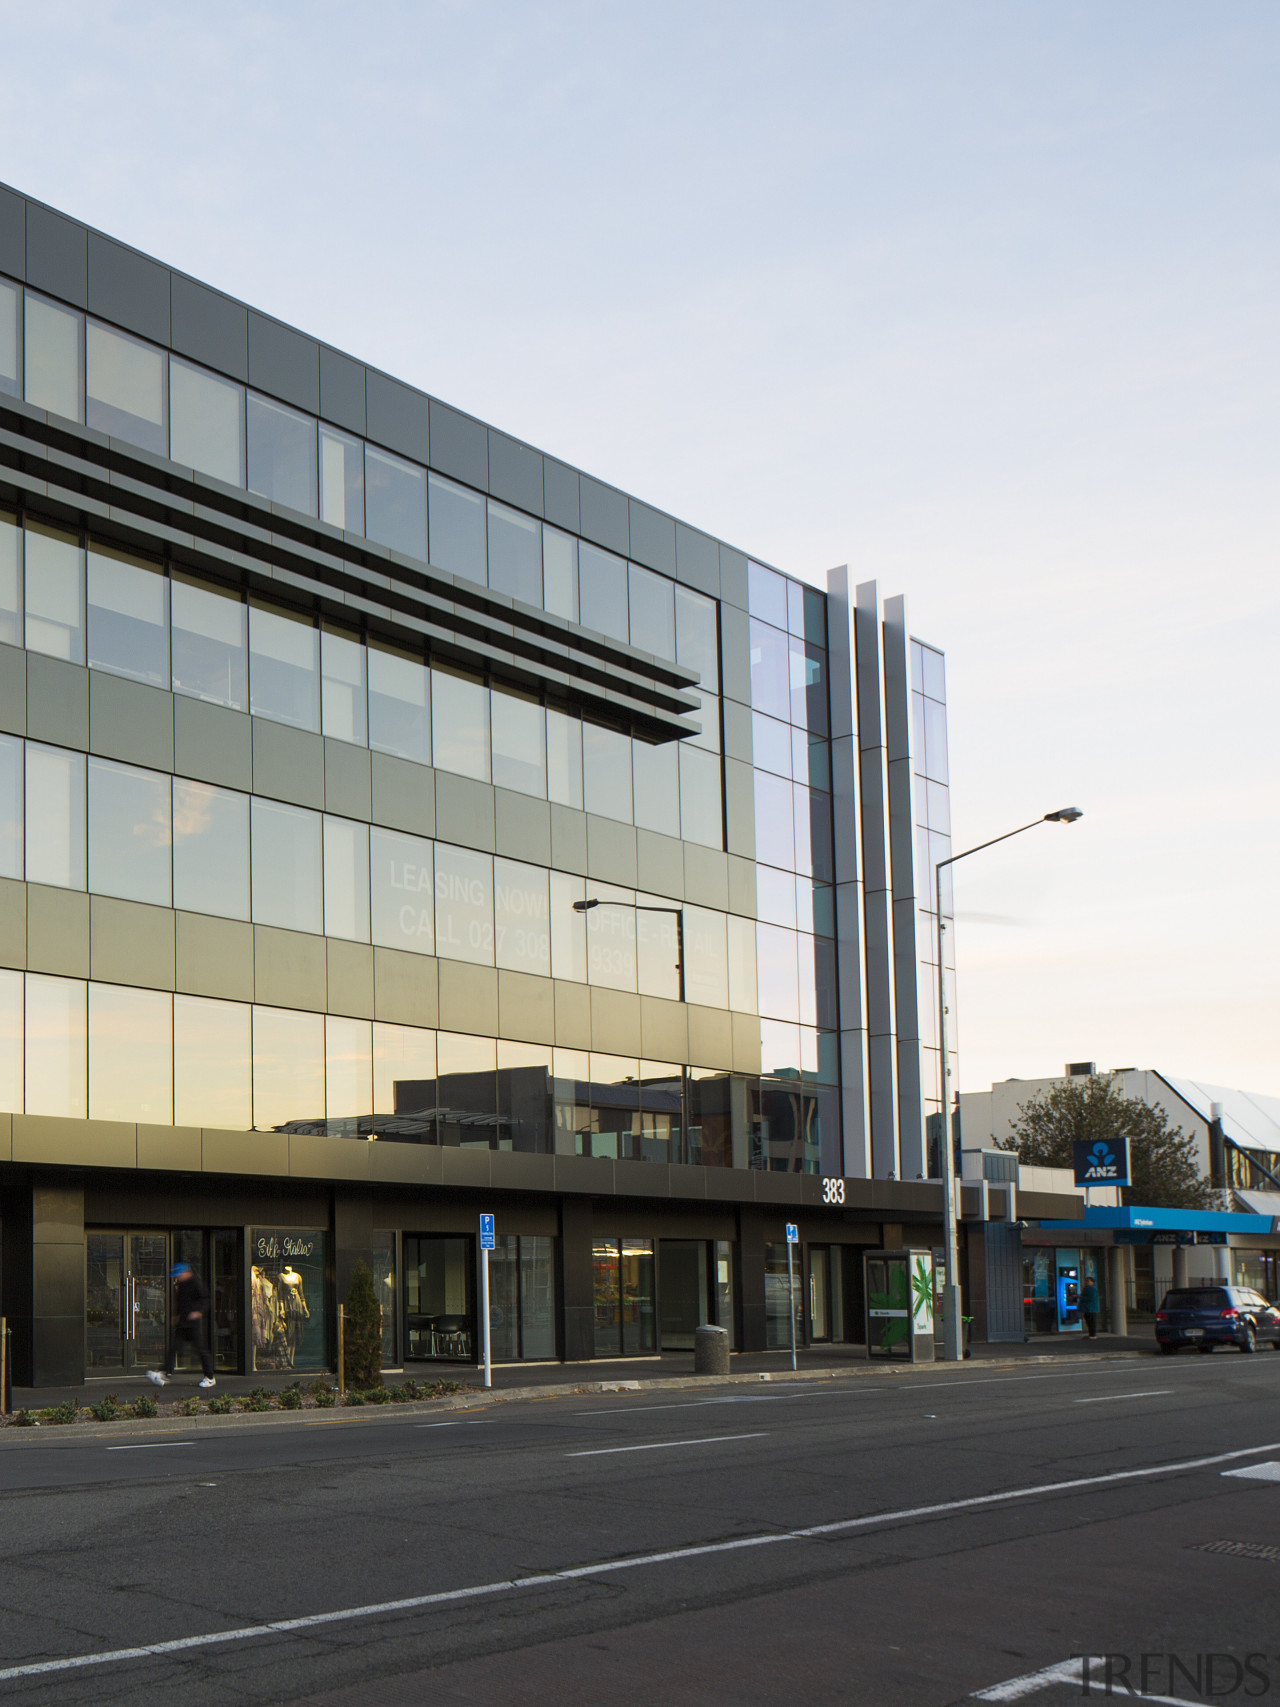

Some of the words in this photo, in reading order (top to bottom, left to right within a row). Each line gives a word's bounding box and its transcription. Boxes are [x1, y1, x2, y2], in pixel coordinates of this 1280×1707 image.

[390, 860, 484, 906] LEASING
[497, 884, 548, 920] NOW!
[588, 908, 648, 942] OFFICE
[400, 904, 460, 945] CALL
[469, 920, 506, 953] 027
[516, 929, 549, 961] 308
[1084, 1166, 1117, 1178] ANZ
[822, 1177, 846, 1204] 383
[257, 1236, 280, 1258] Silk
[282, 1236, 314, 1257] Italia
